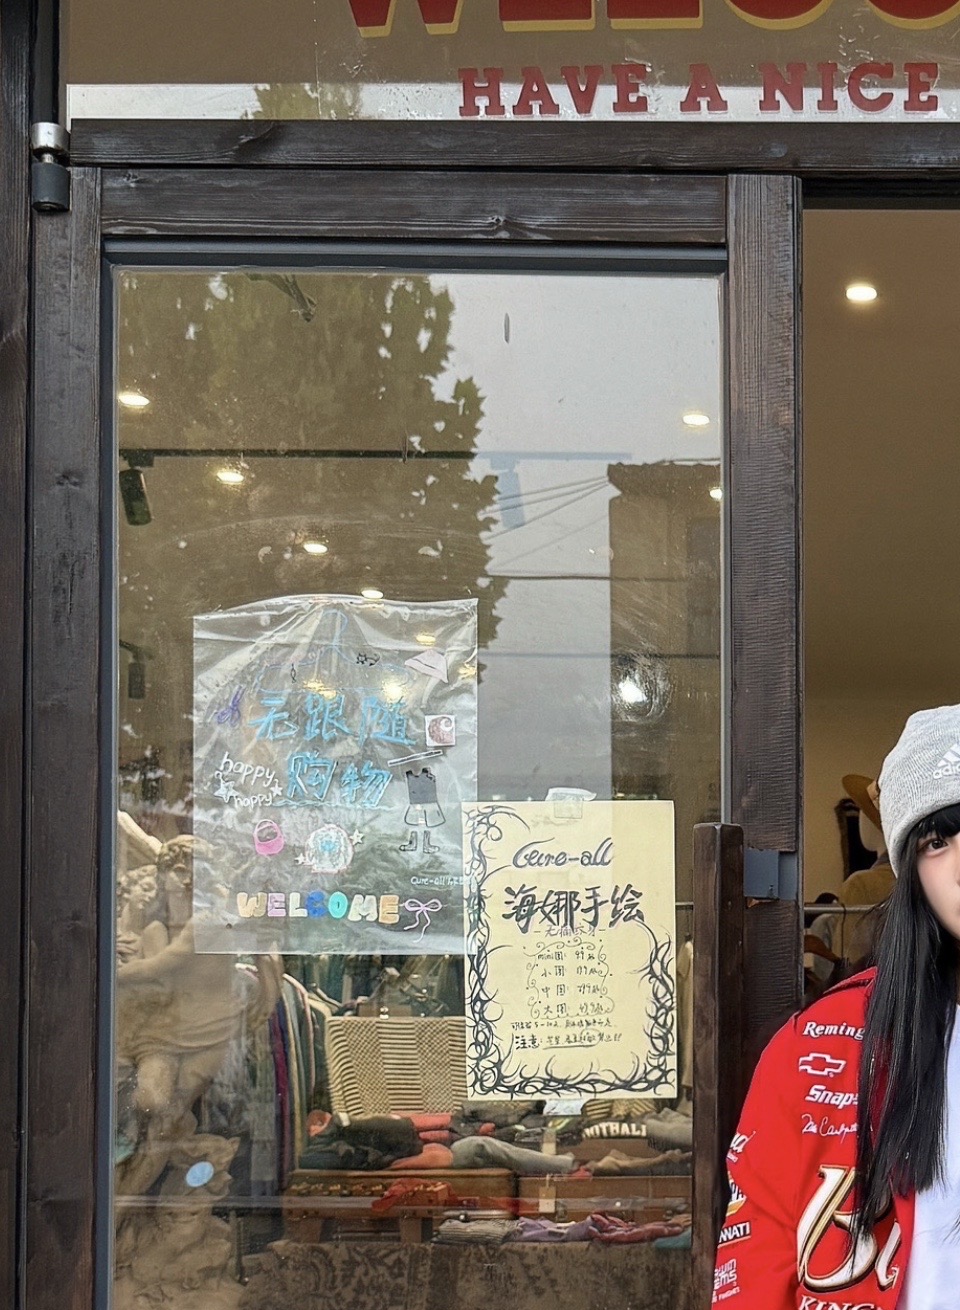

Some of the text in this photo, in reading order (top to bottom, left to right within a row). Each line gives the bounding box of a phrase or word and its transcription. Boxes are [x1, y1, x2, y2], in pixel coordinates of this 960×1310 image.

[459, 65, 648, 117] HAVE
[680, 64, 728, 114] A
[759, 62, 939, 114] NICE
[219, 751, 277, 787] happy
[287, 751, 393, 808] 购物
[236, 891, 400, 925] WELCOME
[502, 883, 646, 935] 海娜手绘
[803, 1021, 865, 1040] Reming
